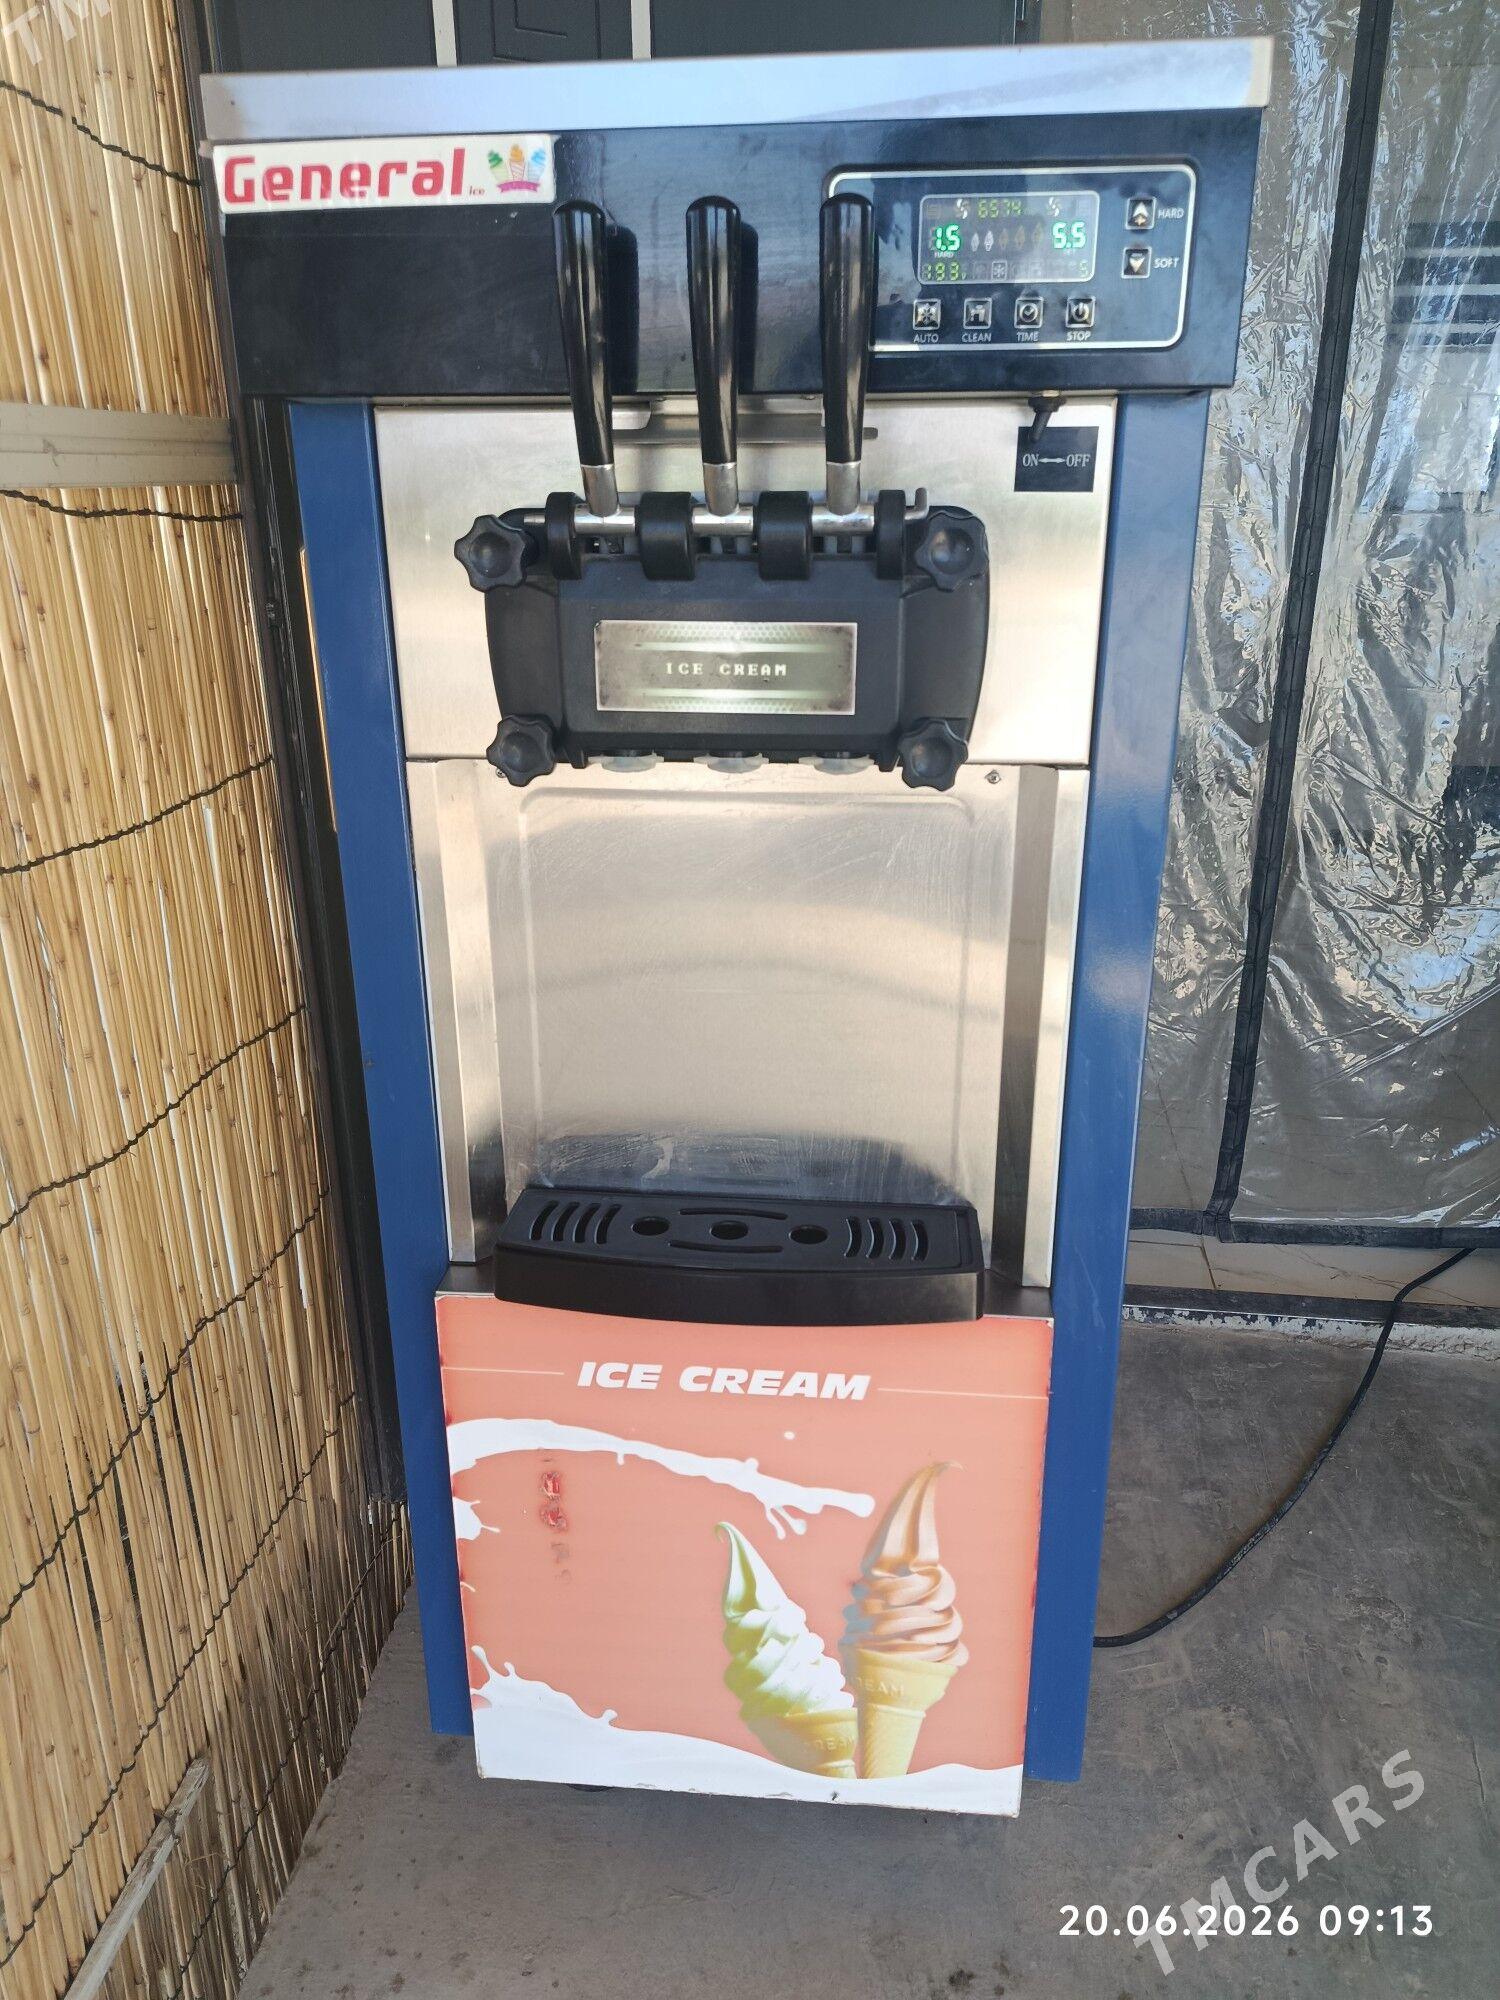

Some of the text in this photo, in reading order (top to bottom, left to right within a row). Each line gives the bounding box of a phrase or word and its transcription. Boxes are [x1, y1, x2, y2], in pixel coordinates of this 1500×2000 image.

[224, 148, 466, 204] General
[1157, 208, 1185, 219] HARD
[1052, 221, 1087, 249] 5.5
[1154, 257, 1180, 269] SOFT
[913, 333, 940, 343] AUTO
[961, 332, 992, 343] CLEAN
[1016, 331, 1040, 342] TIME
[1066, 330, 1092, 341] STOP
[1022, 453, 1091, 467] ON OFF
[666, 662, 787, 676] ICE CREAM
[577, 1361, 872, 1400] ICE CREAM
